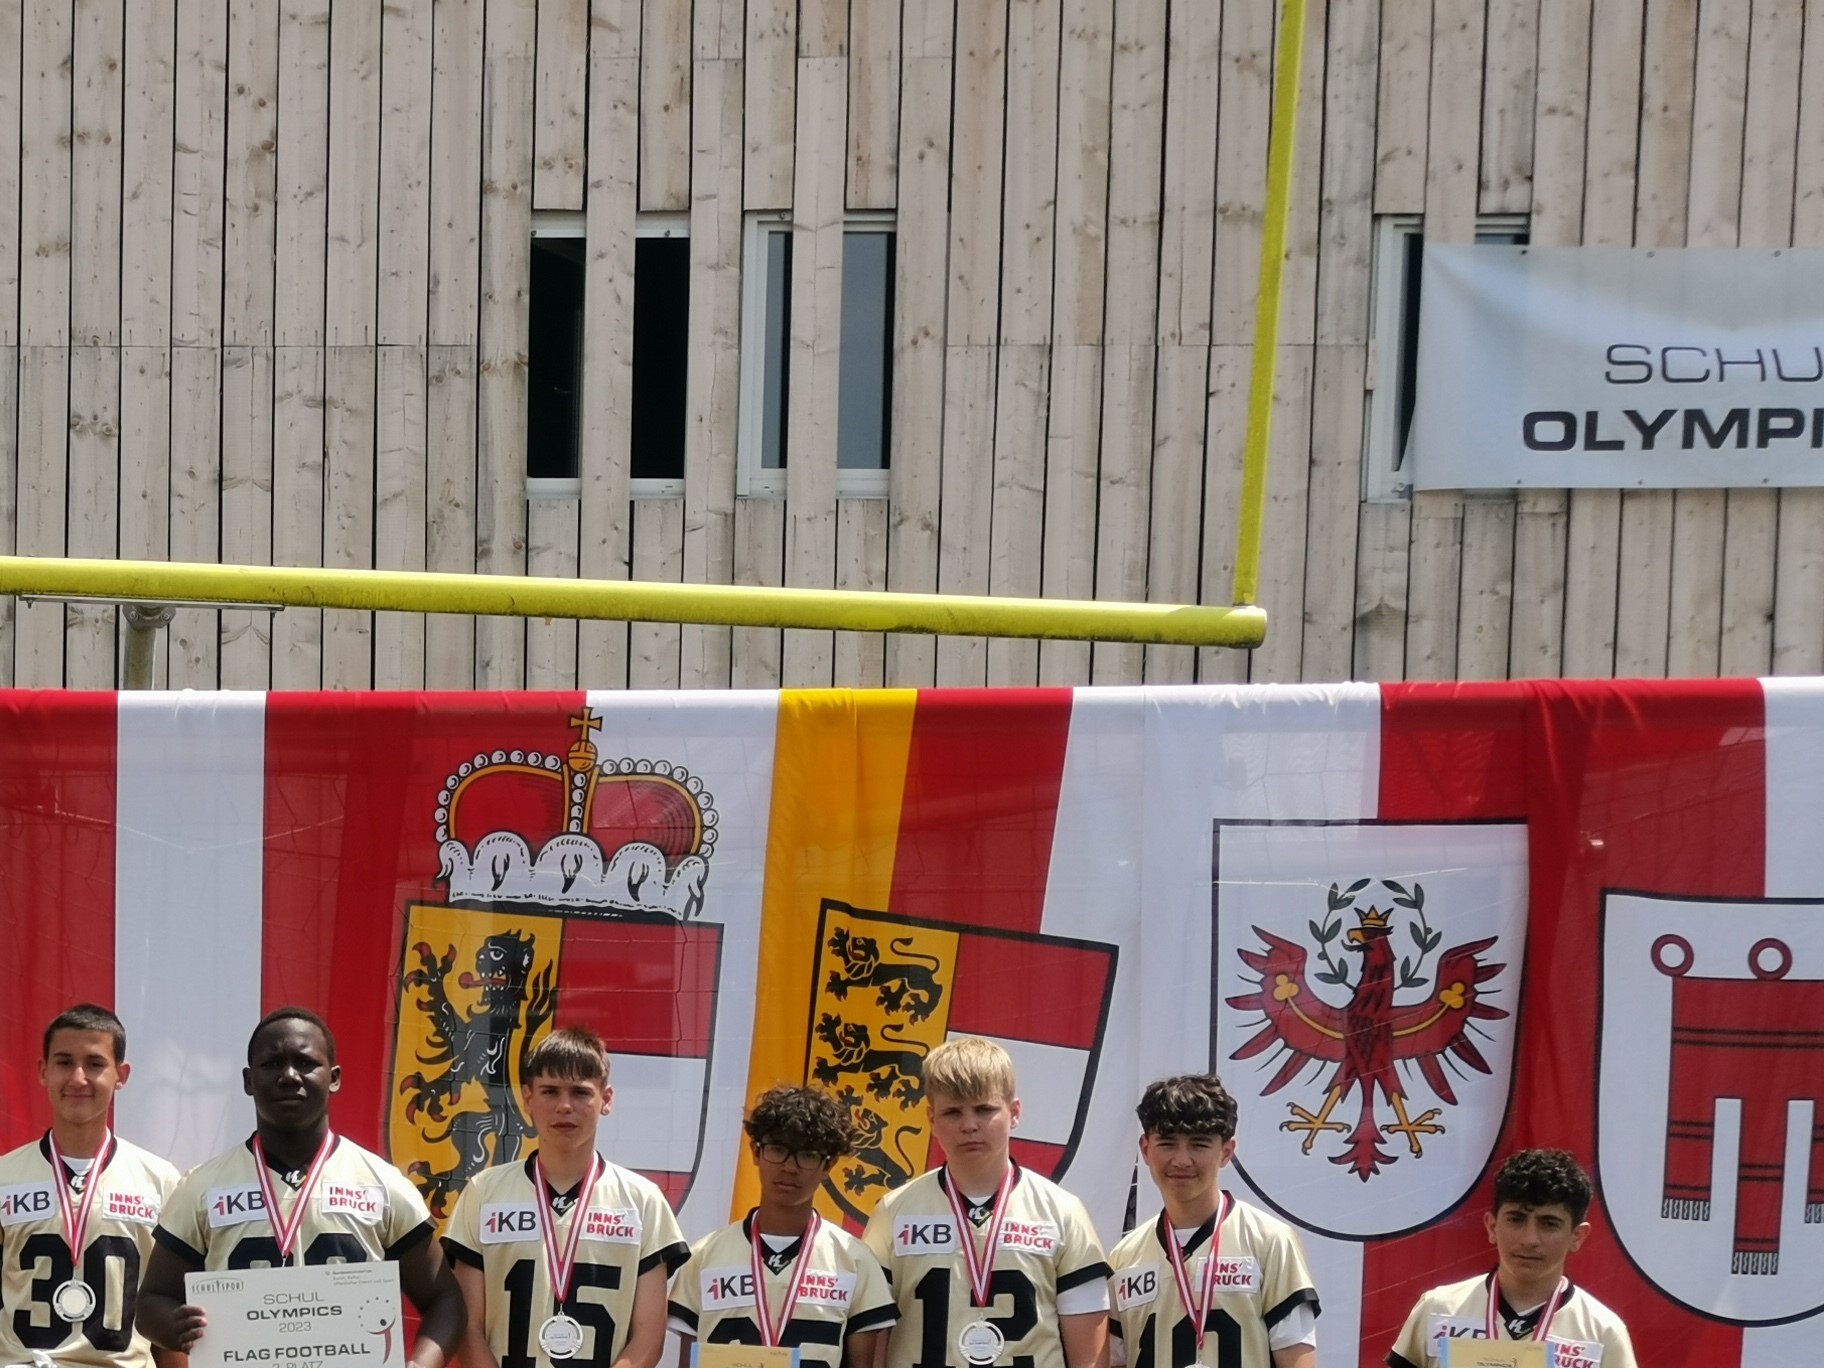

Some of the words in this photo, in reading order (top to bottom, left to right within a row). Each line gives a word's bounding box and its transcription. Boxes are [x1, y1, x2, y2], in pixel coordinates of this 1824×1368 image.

[1605, 344, 1824, 385] SCHU
[1523, 408, 1824, 451] OLYMPI
[110, 1203, 155, 1219] BRUCK
[329, 1196, 377, 1213] BRUCK
[587, 1223, 634, 1238] BRUCK
[1004, 1233, 1053, 1250] BRUCK
[1213, 1274, 1253, 1287] RUCK
[13, 1233, 141, 1352] 30
[263, 1292, 325, 1305] SCHUL
[800, 1286, 847, 1302] BRUCK
[247, 1305, 343, 1321] OLYMPICS
[279, 1321, 312, 1334] 2023
[224, 1347, 270, 1362] FLAG
[275, 1343, 370, 1360] FOOTBALL
